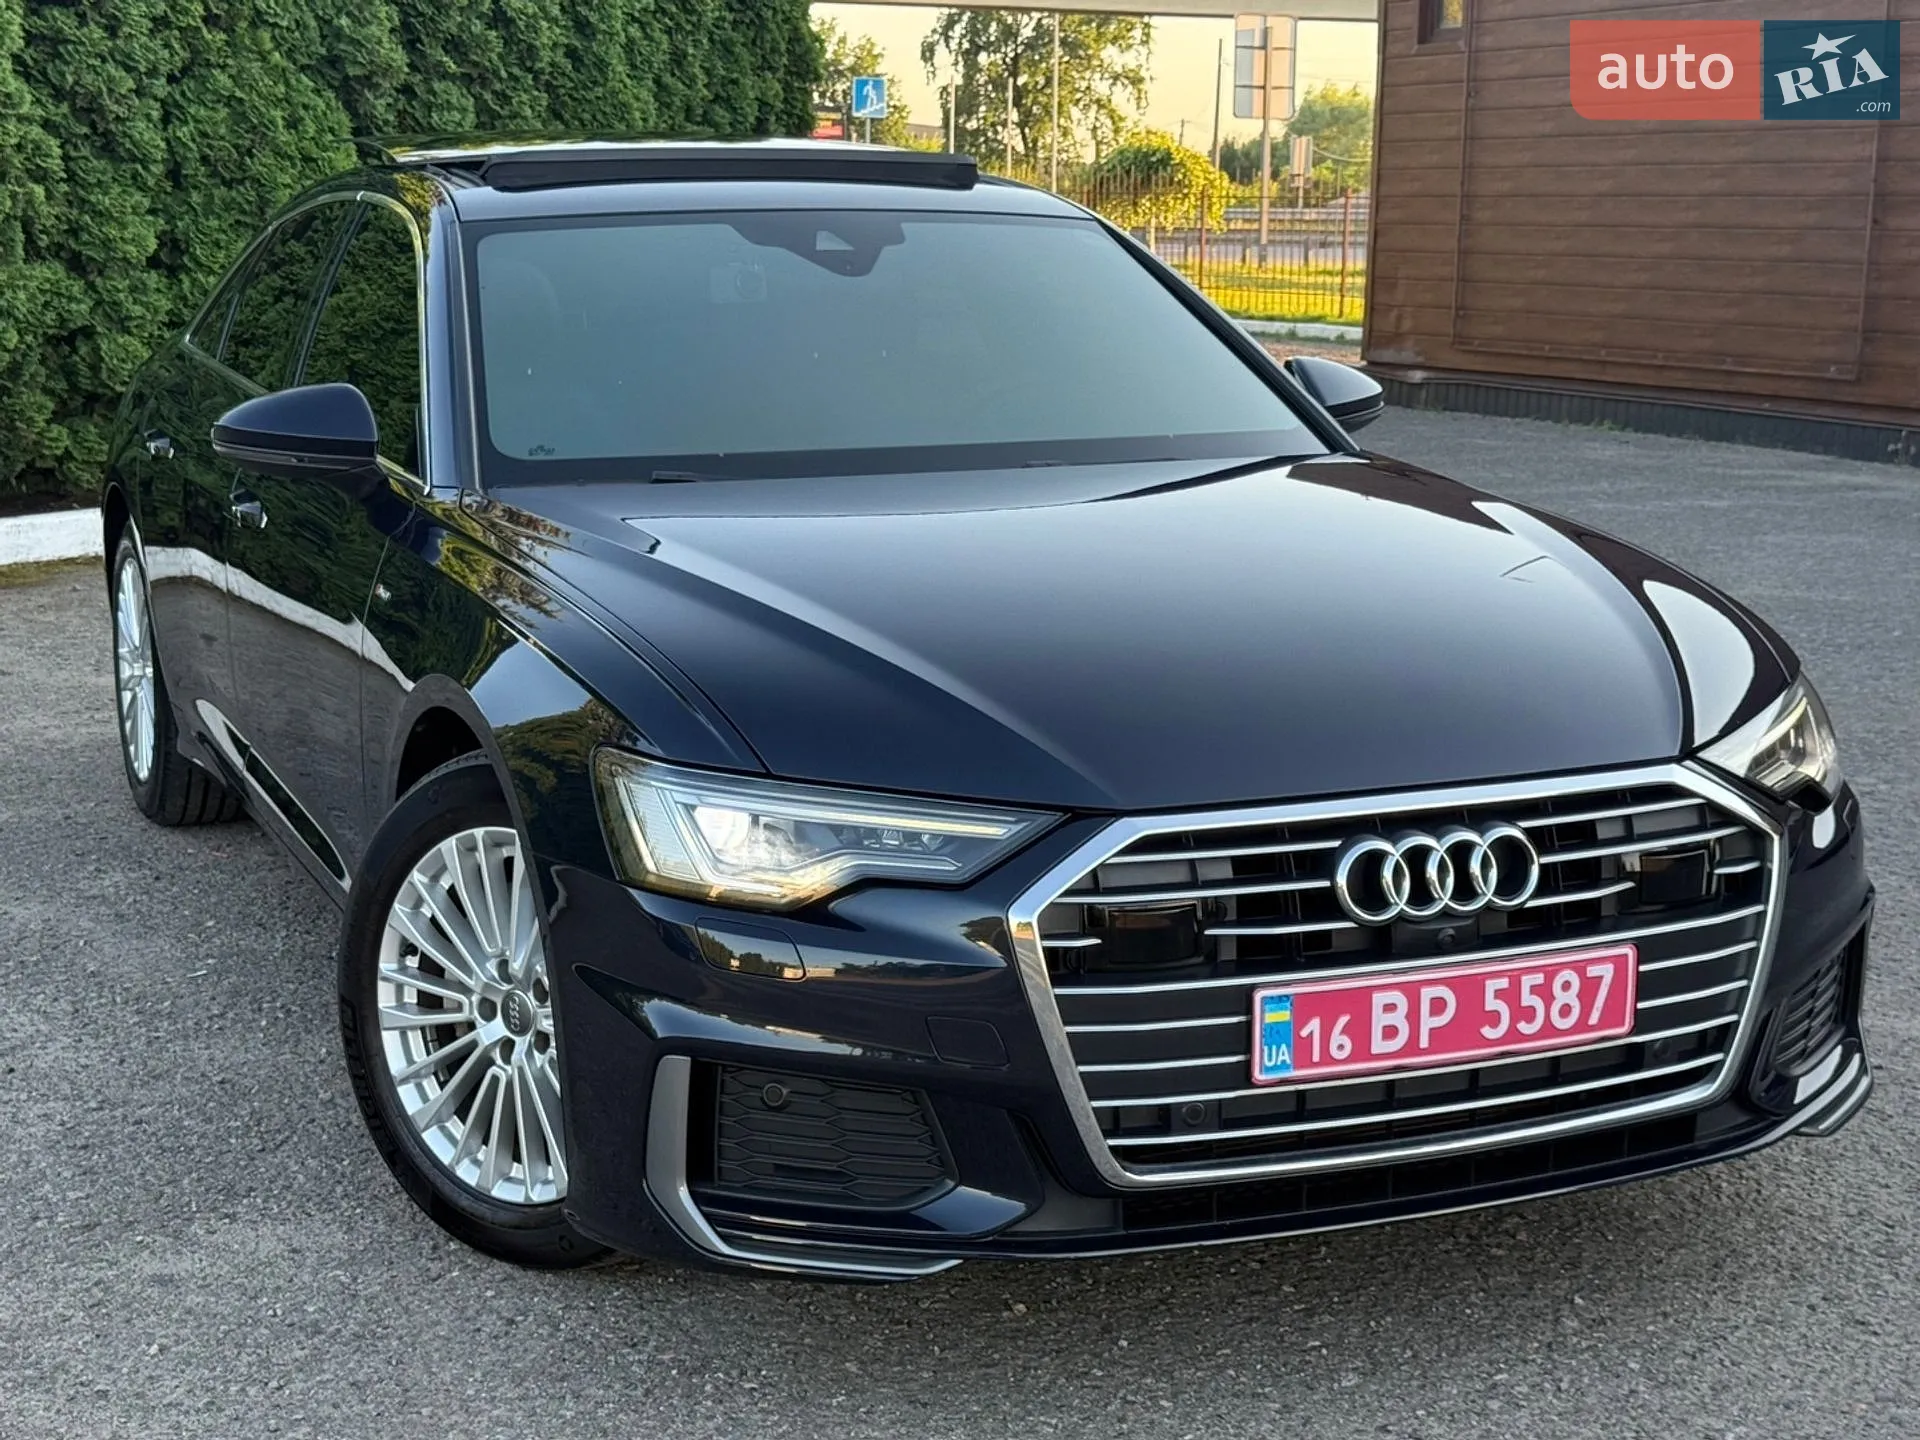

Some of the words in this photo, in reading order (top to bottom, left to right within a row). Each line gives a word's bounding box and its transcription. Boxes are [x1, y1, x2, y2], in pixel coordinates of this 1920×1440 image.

[1300, 1013, 1353, 1063] 16
[1370, 986, 1457, 1055] BP
[1480, 963, 1614, 1040] 5587
[1263, 1043, 1291, 1067] UA
